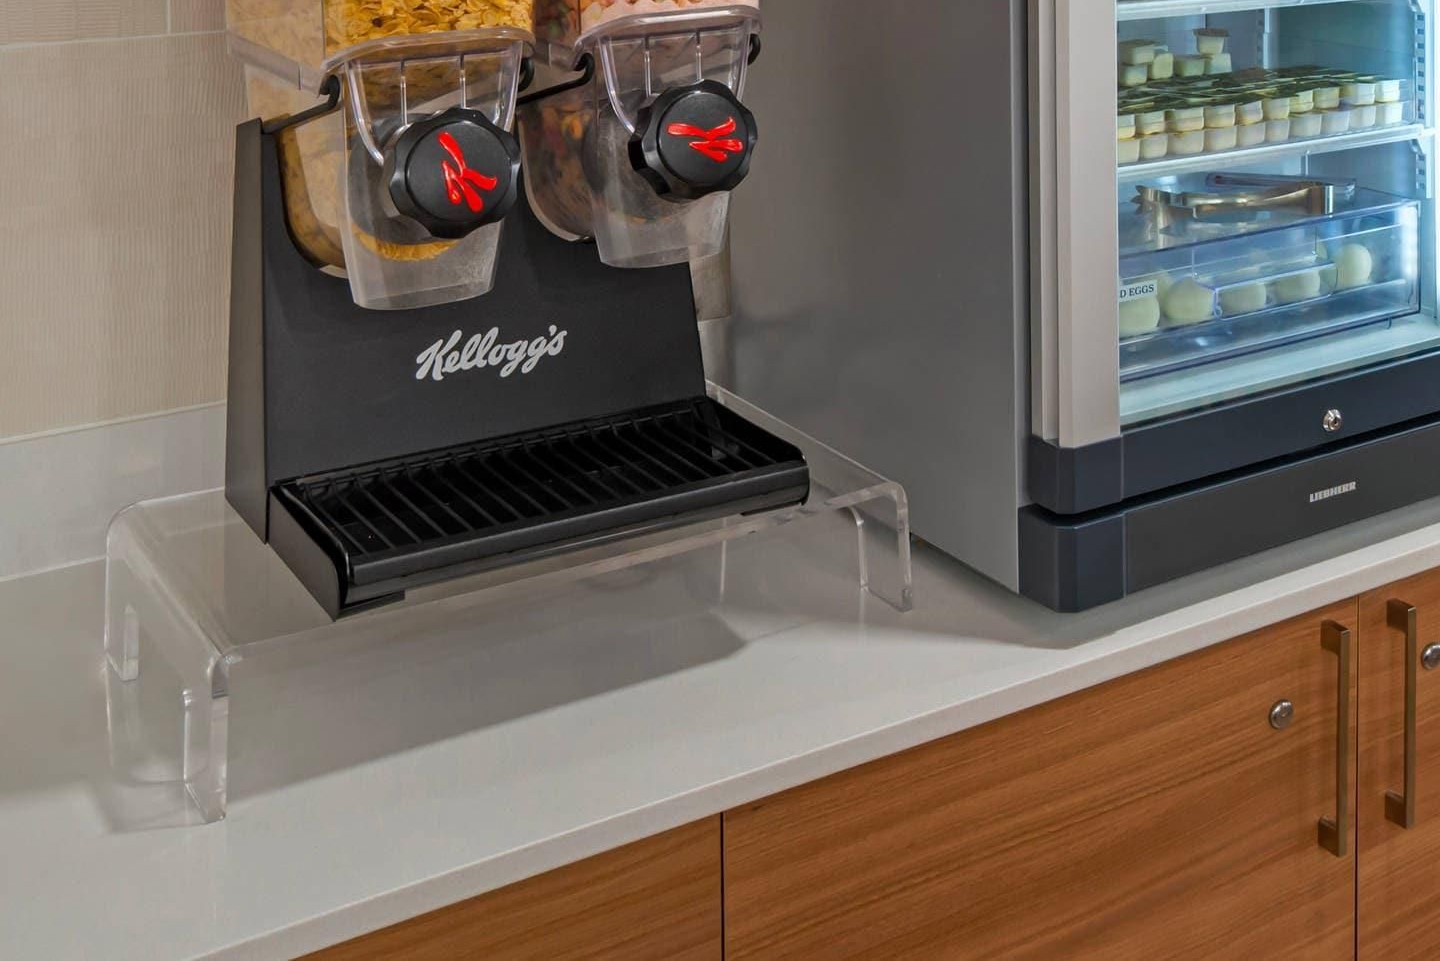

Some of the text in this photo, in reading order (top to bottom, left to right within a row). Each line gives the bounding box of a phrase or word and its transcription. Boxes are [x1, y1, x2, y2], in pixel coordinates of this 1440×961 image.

[1129, 284, 1154, 296] EGGS
[416, 324, 568, 381] Kellogg's
[1310, 482, 1356, 502] LIEBHERR
